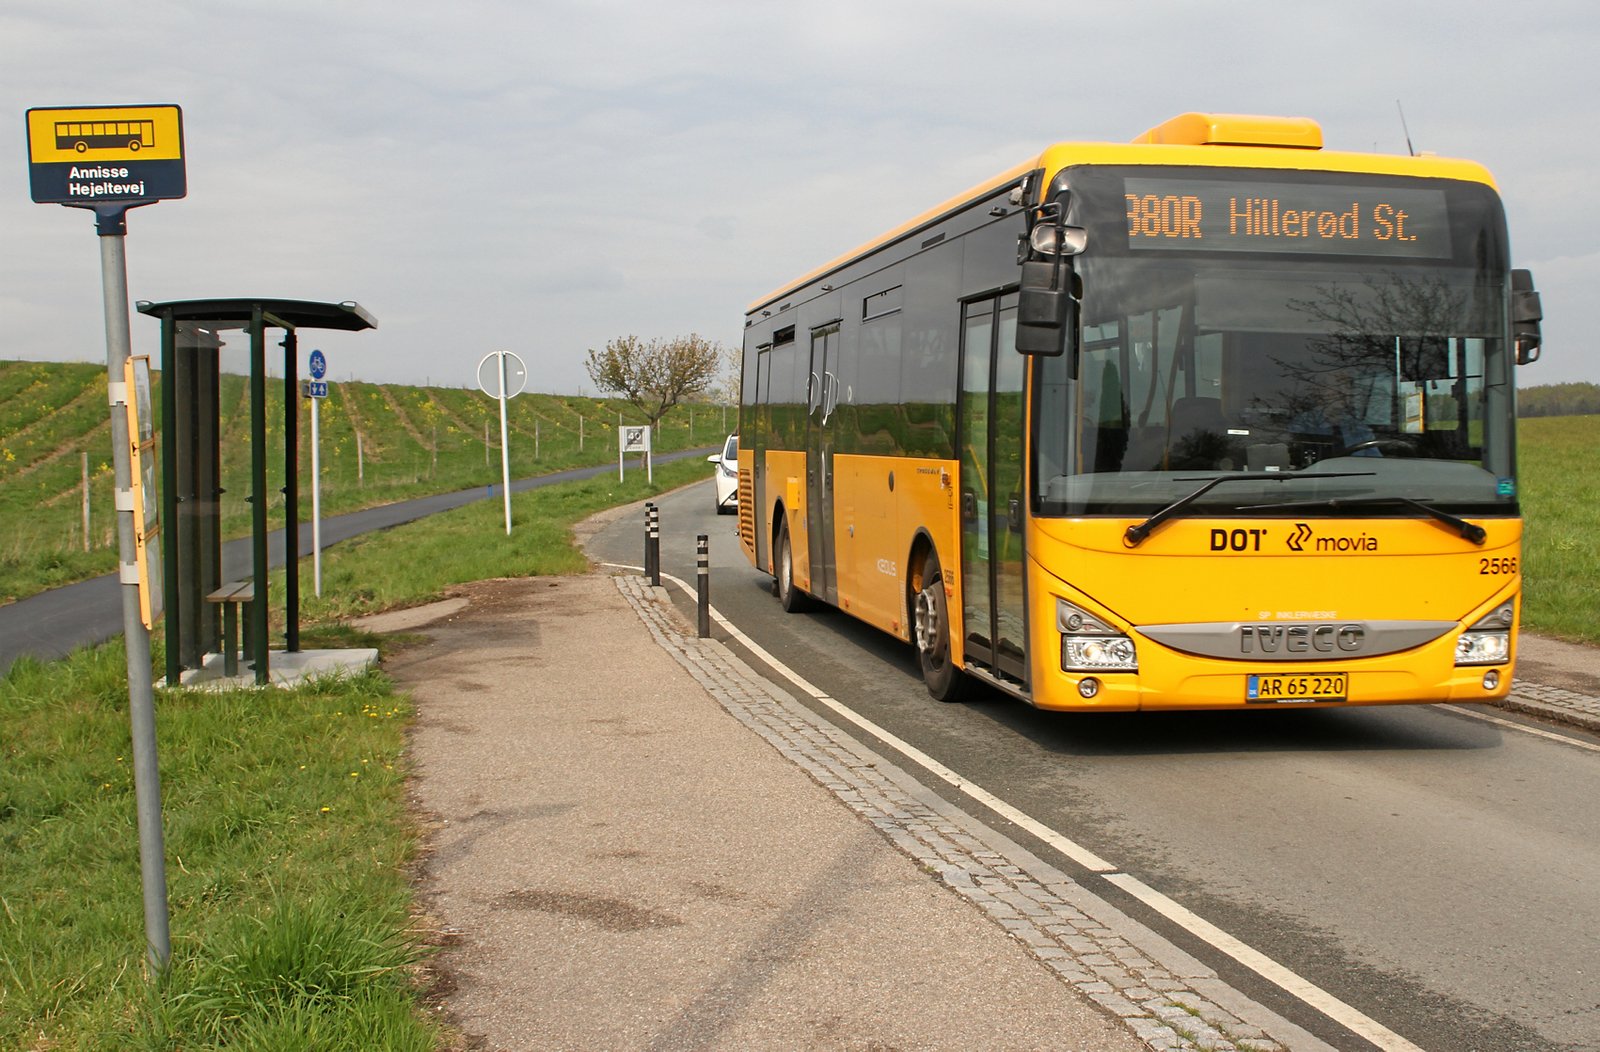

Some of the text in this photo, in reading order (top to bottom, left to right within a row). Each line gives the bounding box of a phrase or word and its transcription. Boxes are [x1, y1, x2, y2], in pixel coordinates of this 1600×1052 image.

[69, 166, 128, 179] Annisse
[69, 181, 144, 197] Hejeltevej
[1229, 196, 1360, 240] Hillerød
[1373, 202, 1418, 241] St.
[628, 432, 641, 440] 40
[1210, 528, 1378, 552] DOT movia
[1479, 556, 1517, 575] 2566
[1240, 623, 1366, 653] IVECO
[1260, 677, 1344, 696] AR 65 220
